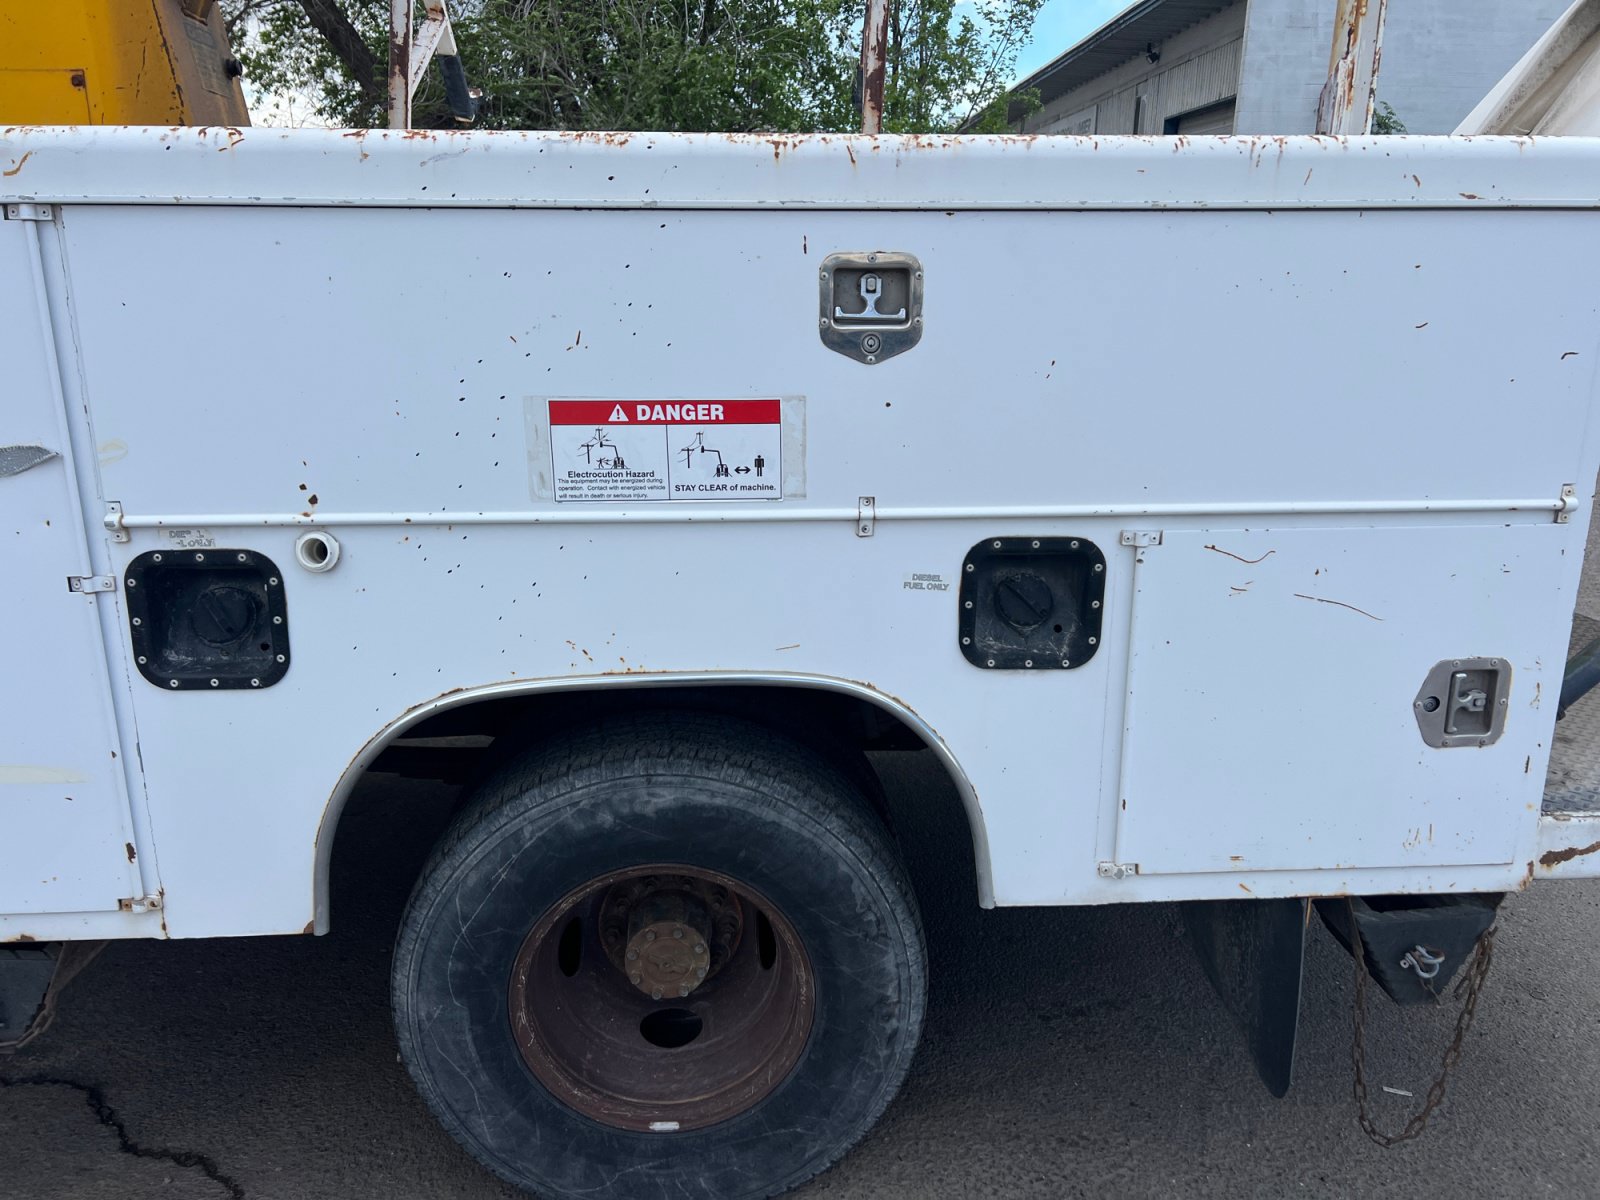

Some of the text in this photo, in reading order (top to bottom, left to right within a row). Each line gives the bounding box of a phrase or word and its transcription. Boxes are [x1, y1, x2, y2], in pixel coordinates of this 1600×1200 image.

[636, 404, 725, 421] DANGER
[568, 470, 655, 479] Electrocution Hazard
[674, 483, 777, 492] STAY CLEAR of machine.
[912, 573, 943, 582] DIESEL
[903, 581, 950, 591] FUEL ONLY
